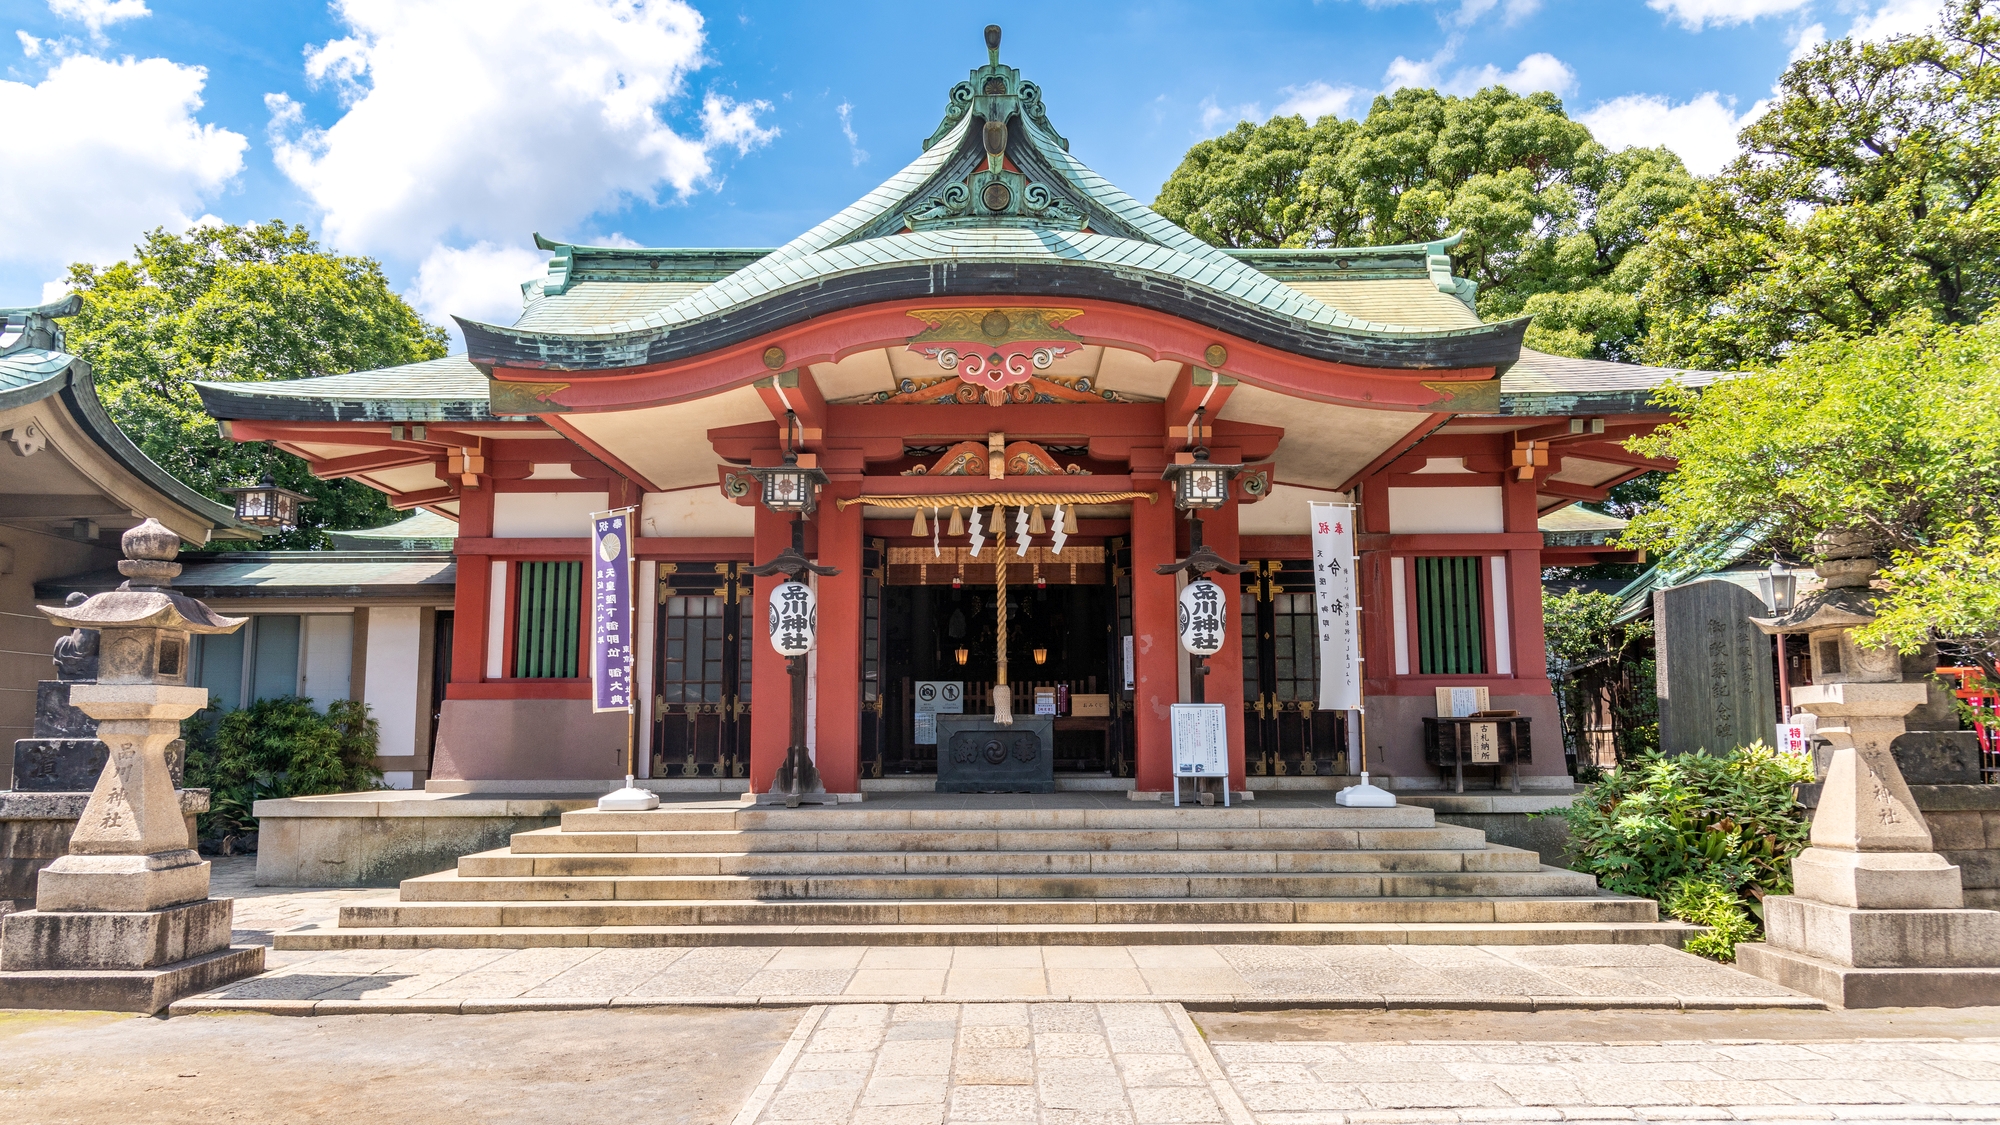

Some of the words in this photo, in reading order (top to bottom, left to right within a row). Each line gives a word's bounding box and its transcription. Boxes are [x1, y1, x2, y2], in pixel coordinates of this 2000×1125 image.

[781, 585, 808, 650] 品川神社
[1192, 584, 1219, 650] 品川神社
[1480, 724, 1490, 760] 古札納所
[1789, 727, 1802, 758] 特別
[99, 742, 136, 830] 品川神社
[1865, 741, 1901, 826] 品川神社
